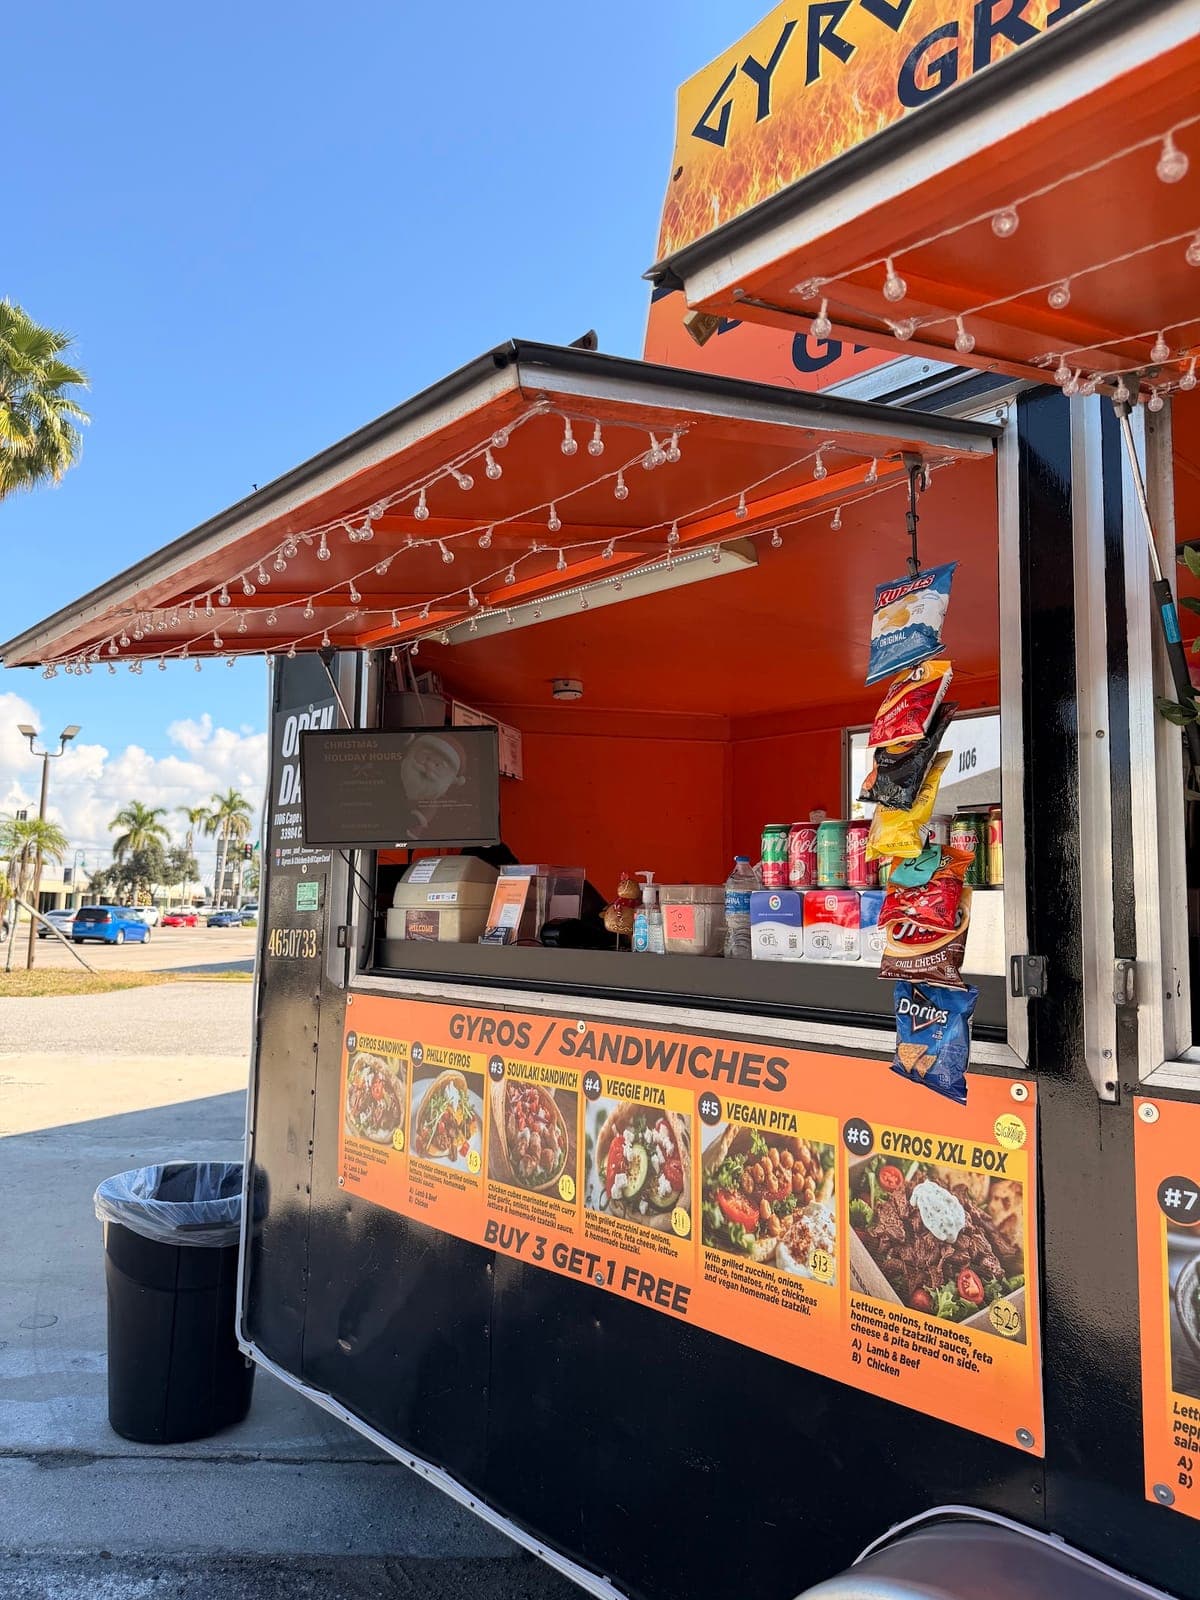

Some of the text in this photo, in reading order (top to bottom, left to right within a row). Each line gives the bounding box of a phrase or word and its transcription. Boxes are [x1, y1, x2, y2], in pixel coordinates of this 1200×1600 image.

[323, 739, 378, 750] CHRISTMAS
[324, 751, 404, 763] HOLIDAY HOURS
[958, 746, 977, 773] 1106
[268, 928, 316, 958] 4650733
[895, 951, 948, 968] CHILI CHEESE
[898, 998, 949, 1024] Doritos
[359, 1036, 378, 1051] GYROS
[378, 1039, 408, 1057] SANDWICH
[412, 1048, 471, 1068] #2 PHILLY GYROS
[450, 1014, 533, 1050] GYROS
[558, 1026, 790, 1092] SANDWICHES
[490, 1061, 579, 1088] #3 SOUVLAKI SANDWICH
[584, 1078, 666, 1105] #4 VEGGIE PITA
[701, 1100, 797, 1132] #5 VEGAN PITA
[847, 1127, 1008, 1173] #6 GYROS XXL BOX
[487, 1184, 576, 1218] Chicken cubes marinated with curry
[1163, 1186, 1198, 1212] #7
[487, 1200, 504, 1211] lettuce
[510, 1207, 537, 1222] homemade
[538, 1216, 556, 1229] tzatziki
[585, 1211, 597, 1221] With
[598, 1216, 616, 1228] grilled
[616, 1222, 639, 1235] zucchini
[640, 1228, 651, 1239] and
[589, 1231, 618, 1248] homemade
[624, 1233, 635, 1244] feta
[658, 1244, 679, 1258] lettuce
[483, 1220, 691, 1314] BUY 3 GET 1 FREE
[704, 1251, 804, 1293] With grilled zucchini, onions,
[810, 1253, 829, 1274] $13
[704, 1261, 818, 1307] lettuce, tomatoes, rice, chickpeas
[704, 1272, 811, 1316] and vegan homemade tzatziki.
[850, 1298, 972, 1347] Lettuce, onions, tomatoes,
[993, 1305, 1021, 1333] $20
[850, 1310, 993, 1365] homemade tzatziki sauce, feta
[850, 1322, 980, 1373] cheese & pita bread on side.
[851, 1338, 921, 1369] A) Lamb & Beef
[851, 1351, 901, 1377] B) Chicken
[1173, 1401, 1200, 1422] Lett
[1174, 1435, 1200, 1453] sala
[1177, 1455, 1193, 1471] A)
[1178, 1472, 1193, 1489] B)
